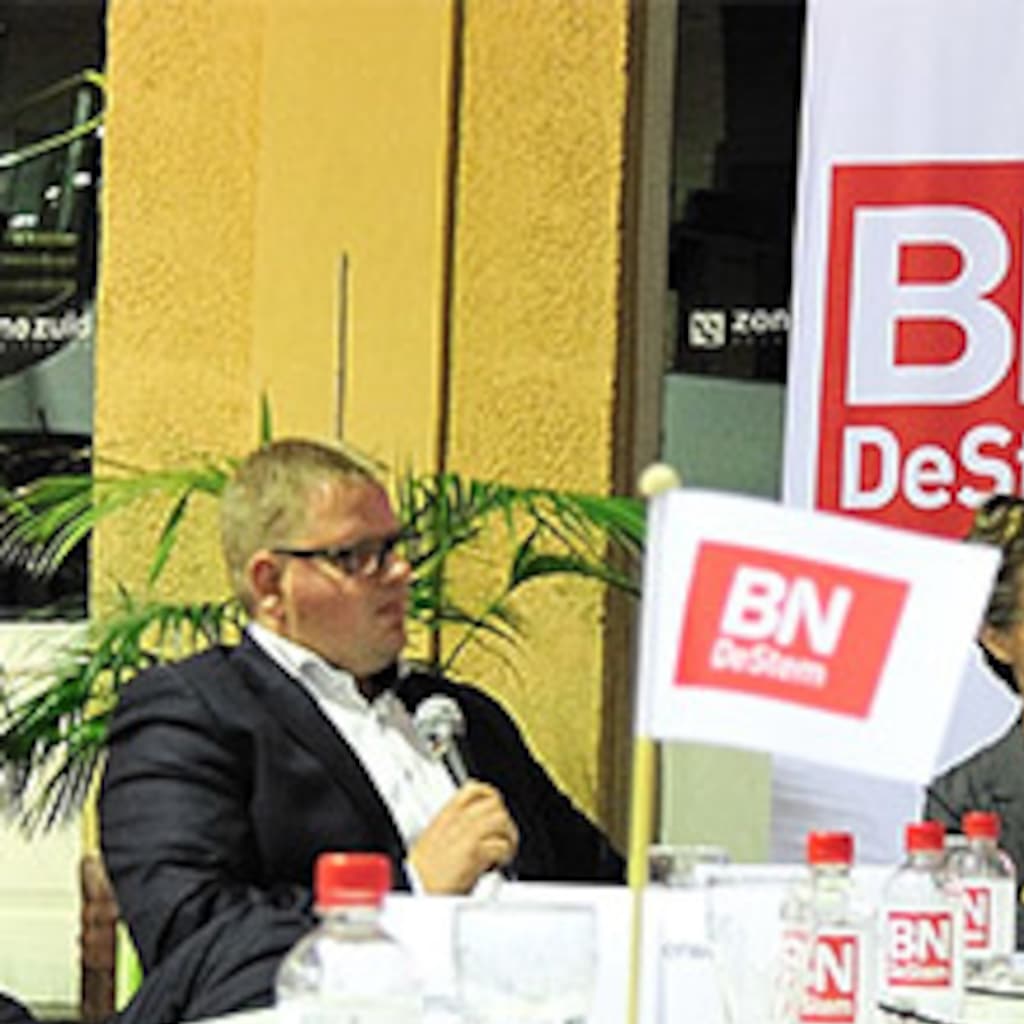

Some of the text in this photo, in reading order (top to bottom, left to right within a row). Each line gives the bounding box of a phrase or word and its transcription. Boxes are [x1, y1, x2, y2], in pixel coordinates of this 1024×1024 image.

[721, 563, 853, 656] BN
[710, 637, 828, 691] DeStem
[890, 920, 950, 961] BN
